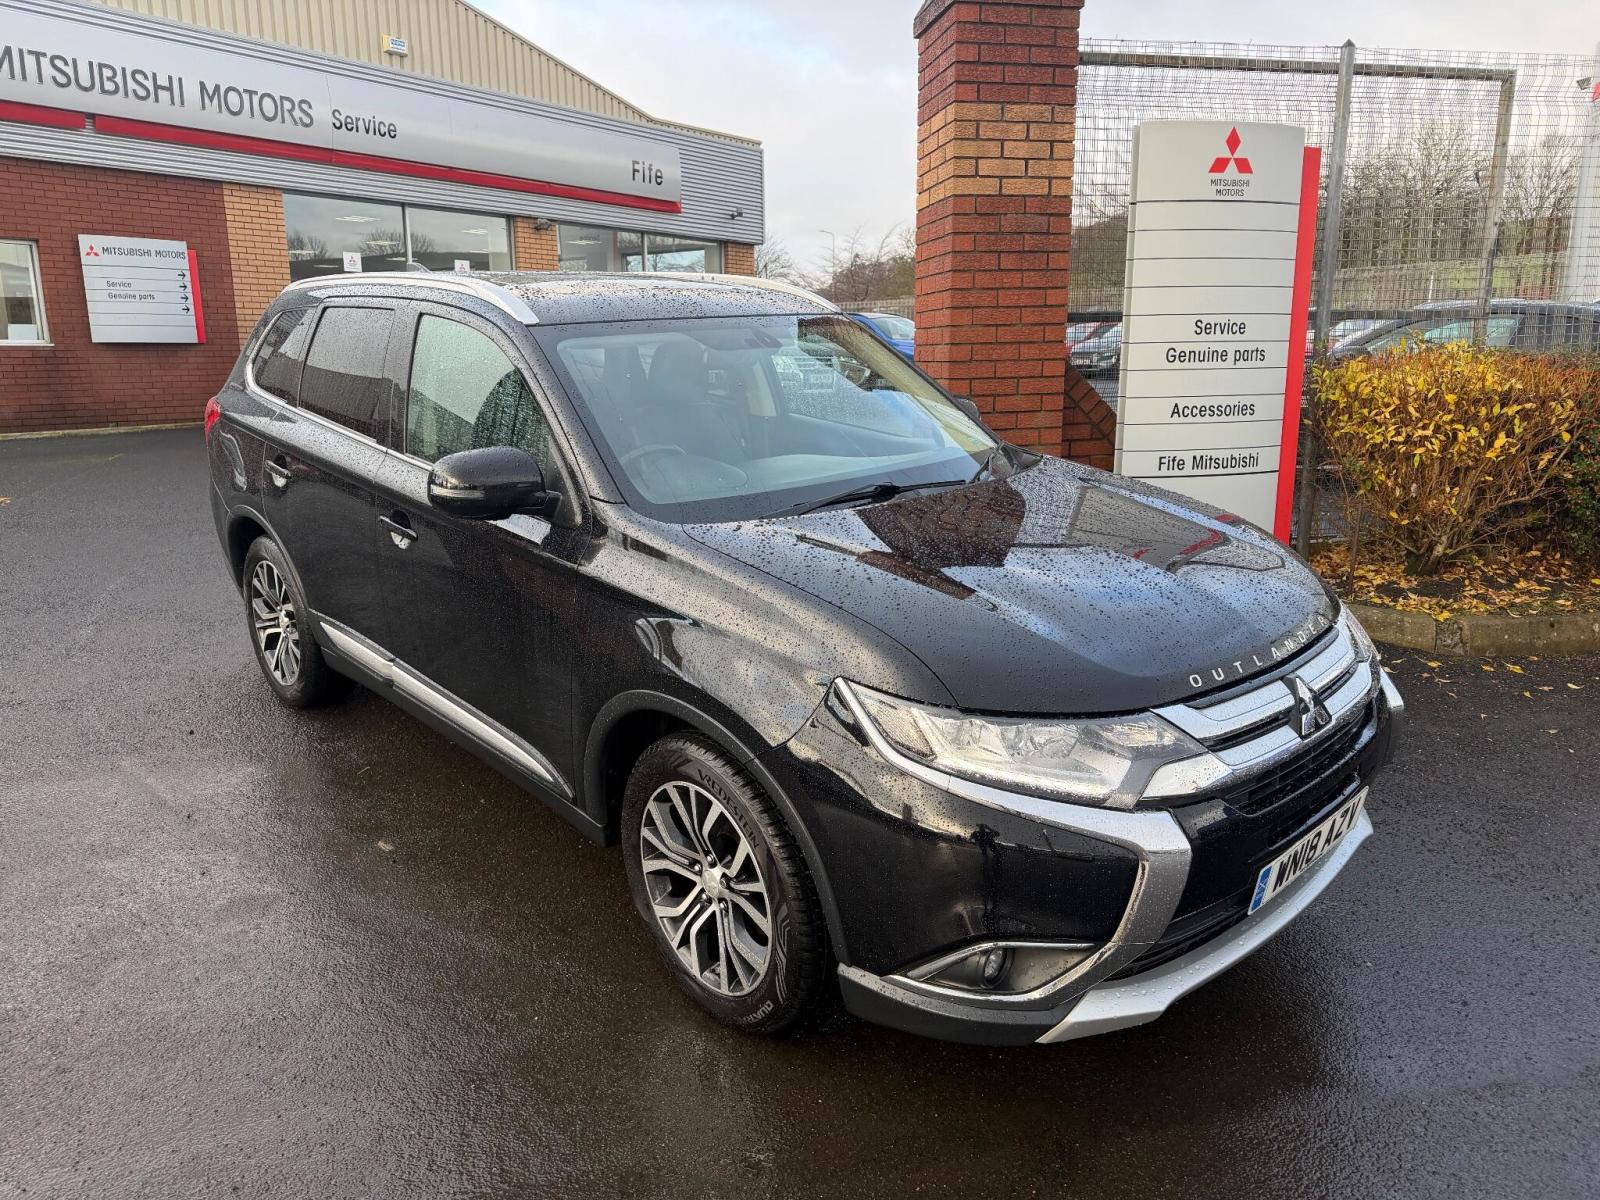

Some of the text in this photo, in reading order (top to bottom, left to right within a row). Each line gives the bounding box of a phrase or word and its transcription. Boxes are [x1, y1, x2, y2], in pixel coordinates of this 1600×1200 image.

[199, 80, 315, 129] MOTORS
[332, 109, 398, 139] Service
[631, 160, 664, 186] Fife
[1210, 178, 1250, 187] MITSUBISHI
[1215, 188, 1245, 197] MOTORS
[101, 246, 186, 260] MITSUBISHI MOTORS
[106, 280, 132, 289] Service
[108, 292, 156, 302] Genuine parts
[1194, 319, 1247, 336] Service
[1166, 347, 1266, 366] Genuine parts
[1170, 401, 1256, 419] Accessories
[1158, 452, 1260, 472] Fife Mitsubishi
[1188, 615, 1330, 689] OUTLANDER
[1272, 795, 1362, 893] WN18 AZV
